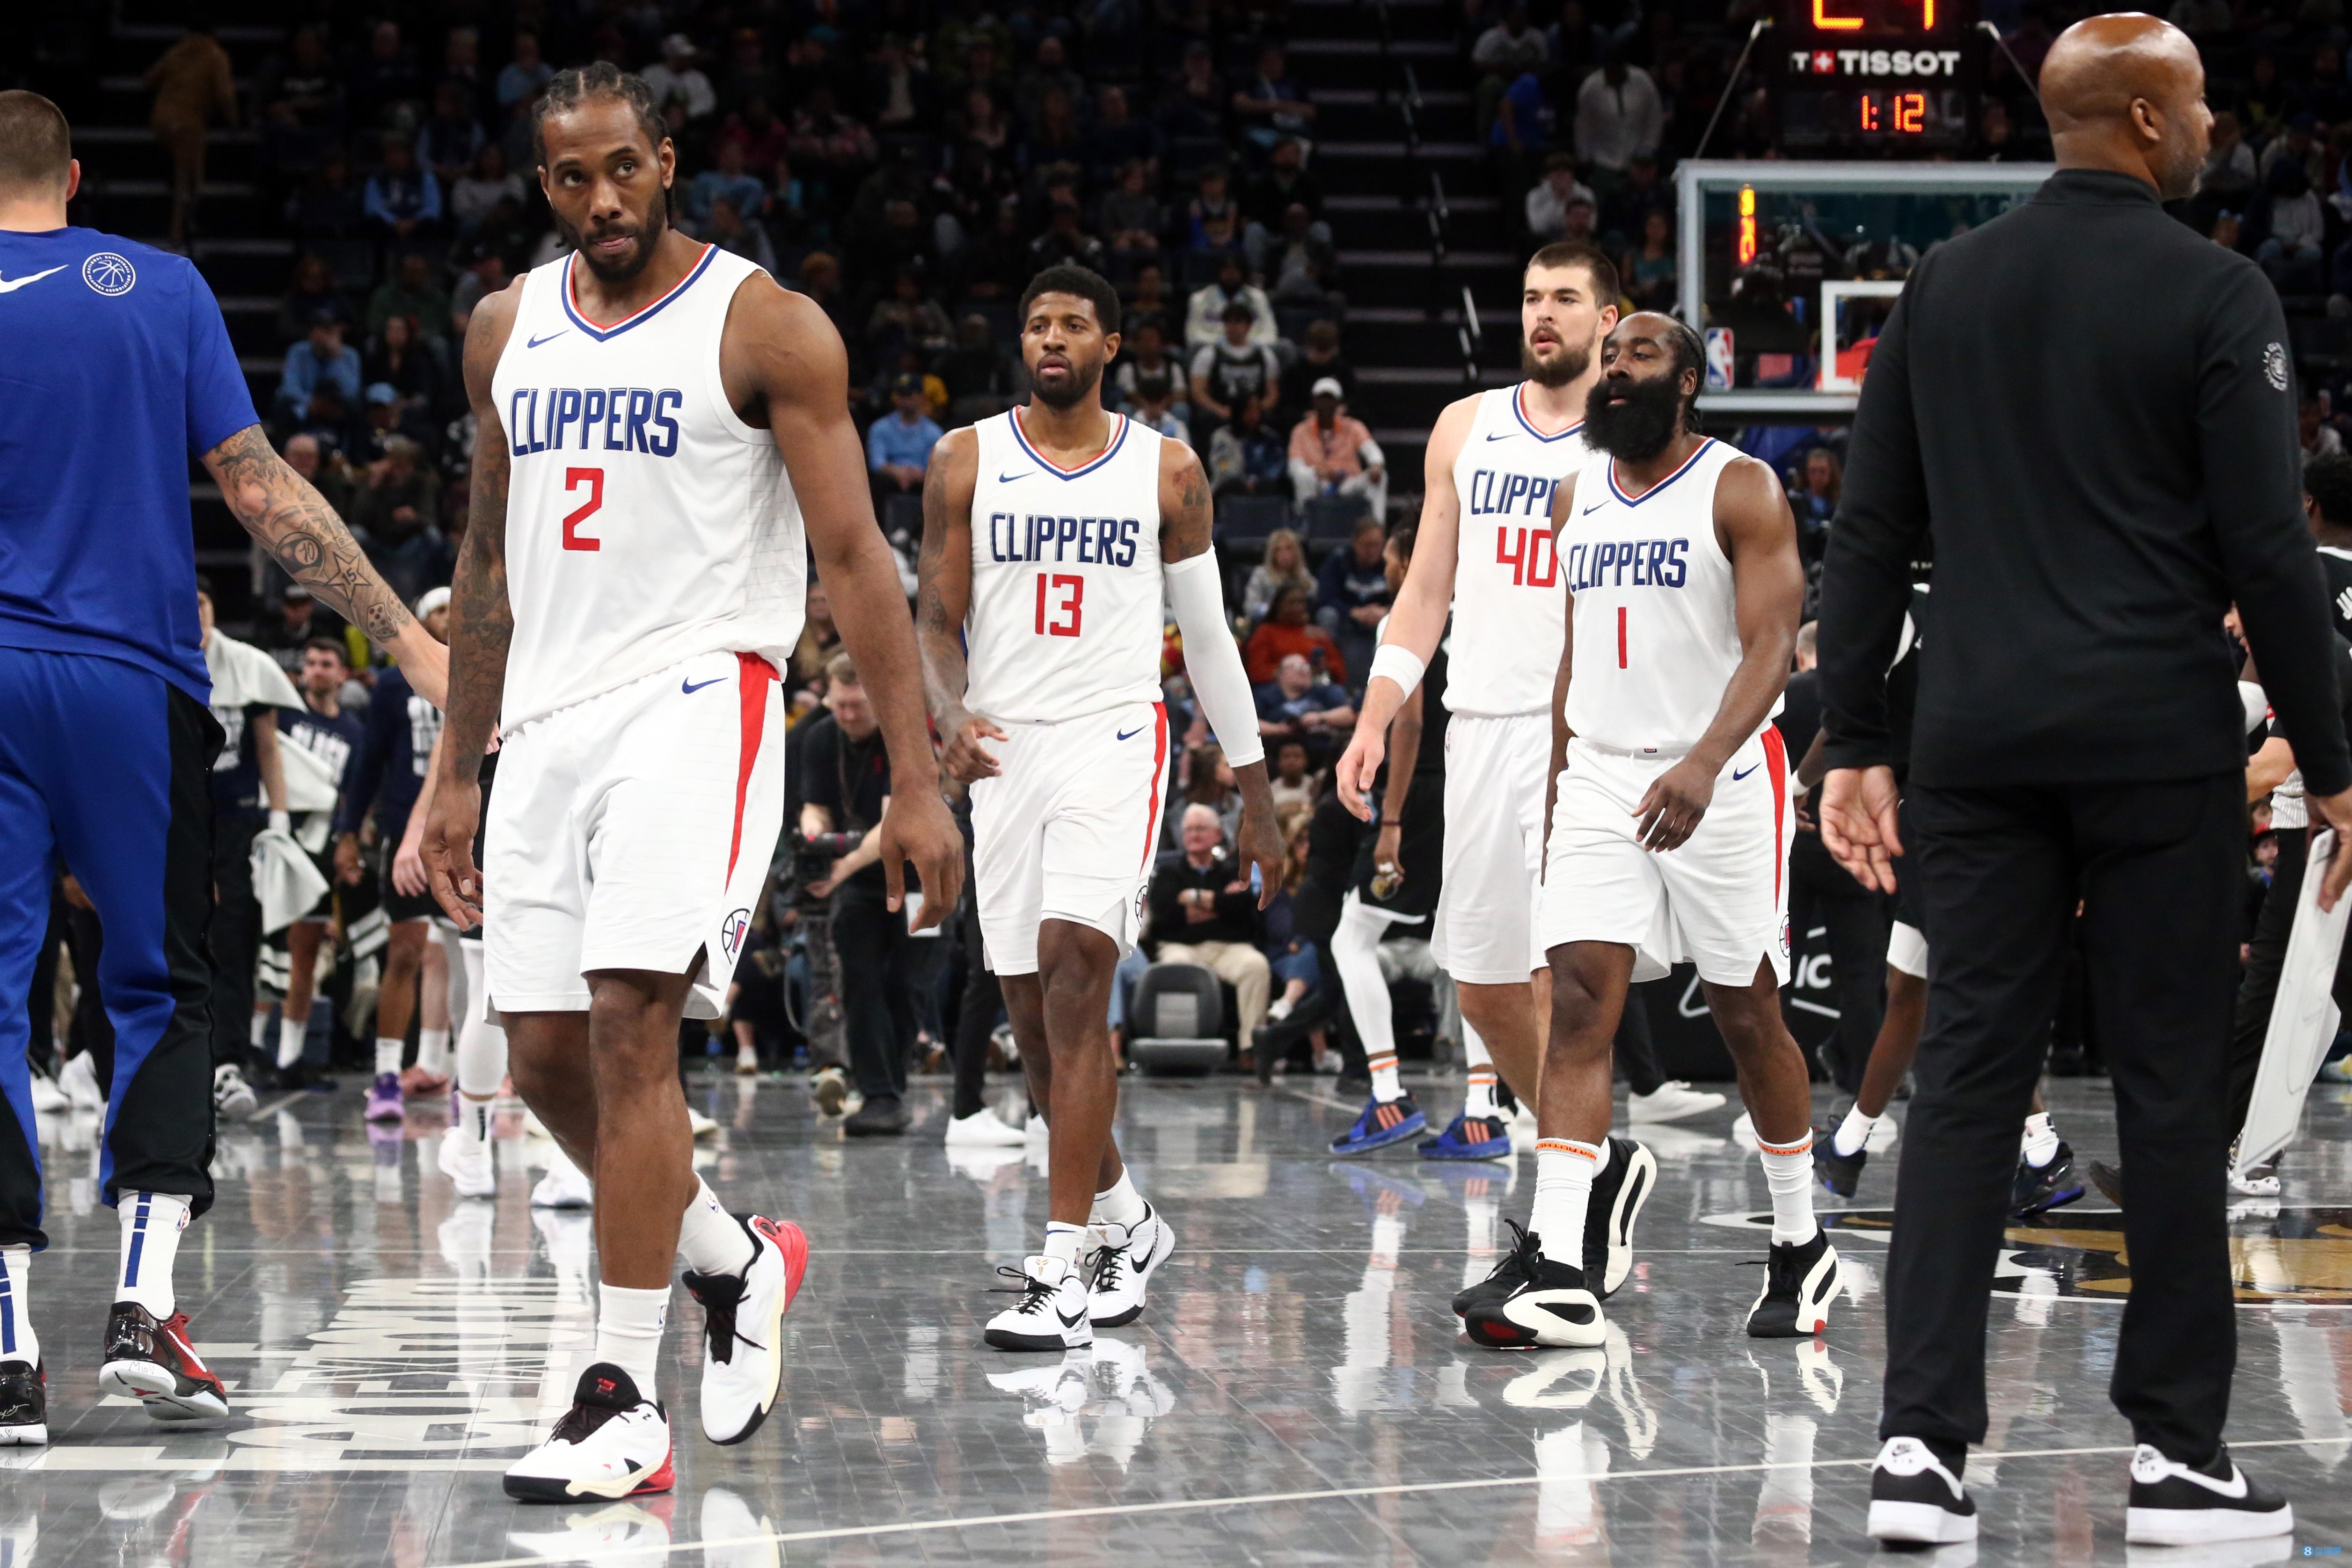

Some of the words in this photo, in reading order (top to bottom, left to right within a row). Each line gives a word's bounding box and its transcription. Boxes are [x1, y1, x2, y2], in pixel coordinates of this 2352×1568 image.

[1838, 50, 1960, 75] TISSOT
[1861, 94, 1924, 131] 1:12
[511, 387, 683, 458] CLIPPERS
[562, 467, 604, 551] 2
[989, 511, 1139, 567] CLIPPERS
[1497, 526, 1558, 588] 40
[1569, 538, 1689, 593] CLIPPERS
[1035, 573, 1084, 637] 13
[1618, 606, 1628, 669] 1
[1794, 953, 1833, 989] IC
